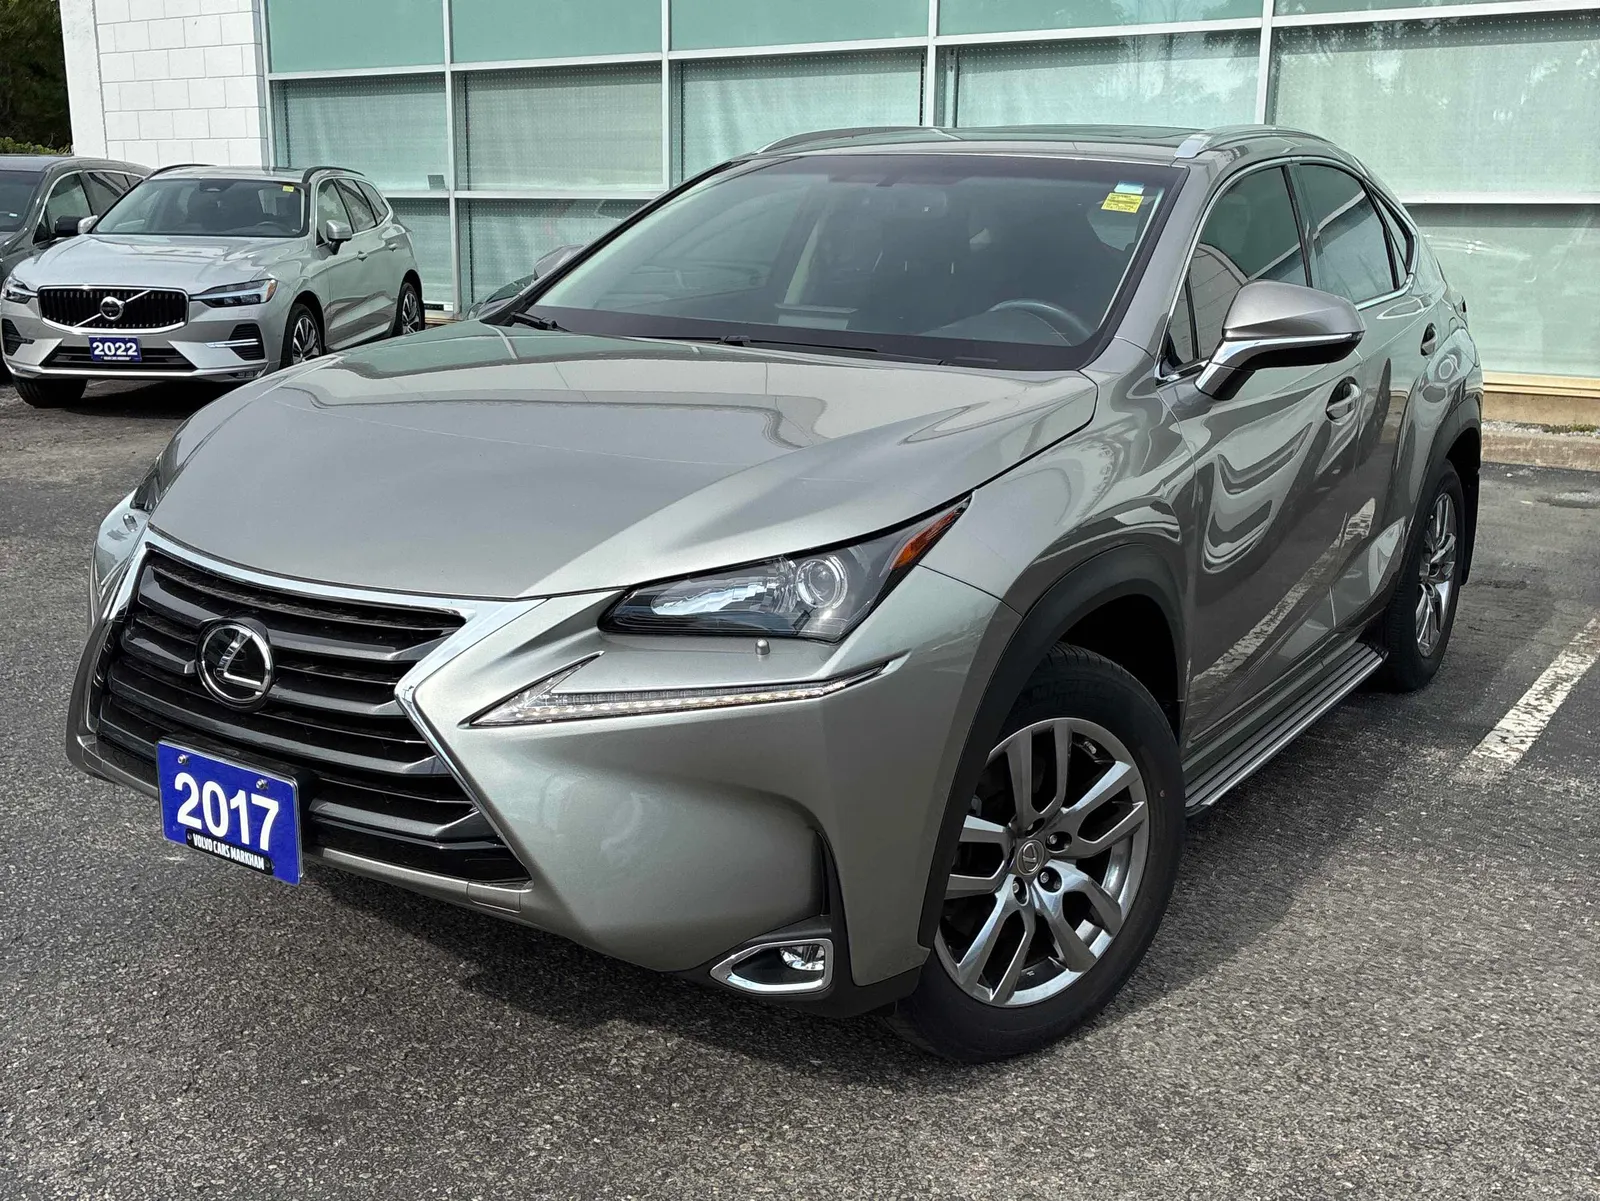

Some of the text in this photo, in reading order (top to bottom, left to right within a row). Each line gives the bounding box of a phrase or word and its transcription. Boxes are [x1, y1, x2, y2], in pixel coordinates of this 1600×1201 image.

[92, 342, 138, 355] 2022
[174, 772, 279, 852] 2017
[192, 833, 265, 870] VOLVO CARS MARKHAM
